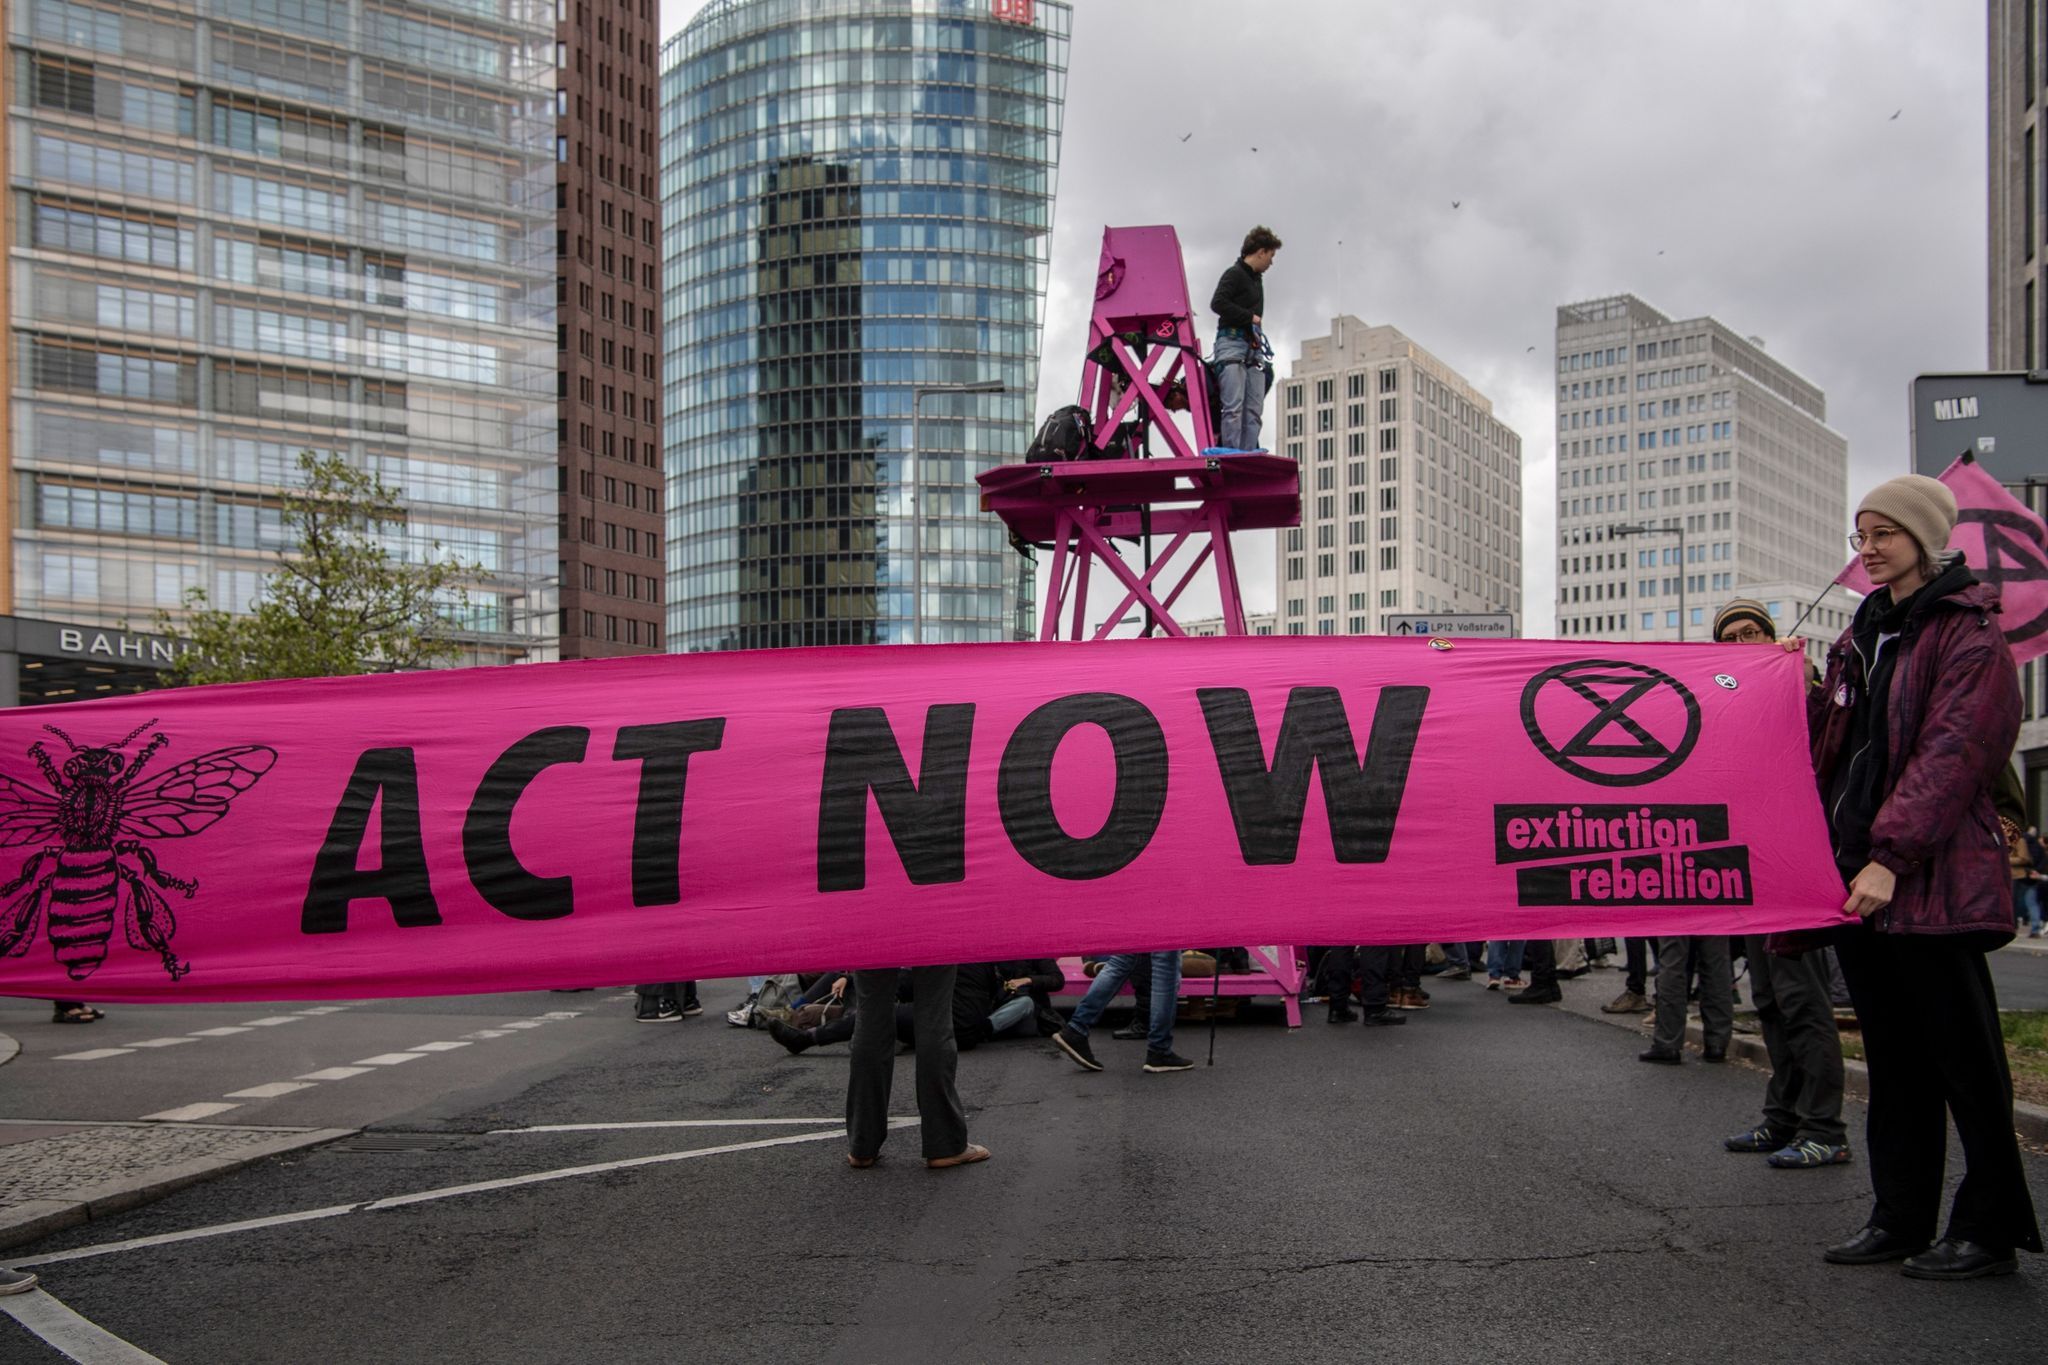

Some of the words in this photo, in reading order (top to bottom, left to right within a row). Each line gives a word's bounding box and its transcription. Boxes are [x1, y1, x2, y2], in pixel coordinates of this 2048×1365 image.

[1934, 396, 1979, 420] MLM
[1431, 622, 1453, 632] LP12
[1457, 622, 1505, 632] Voßstraße
[60, 628, 258, 670] BAHNHF
[301, 717, 725, 934] ACT
[817, 686, 1430, 892] NOW
[1506, 806, 1700, 850] extinction
[1570, 852, 1745, 900] rebellion
